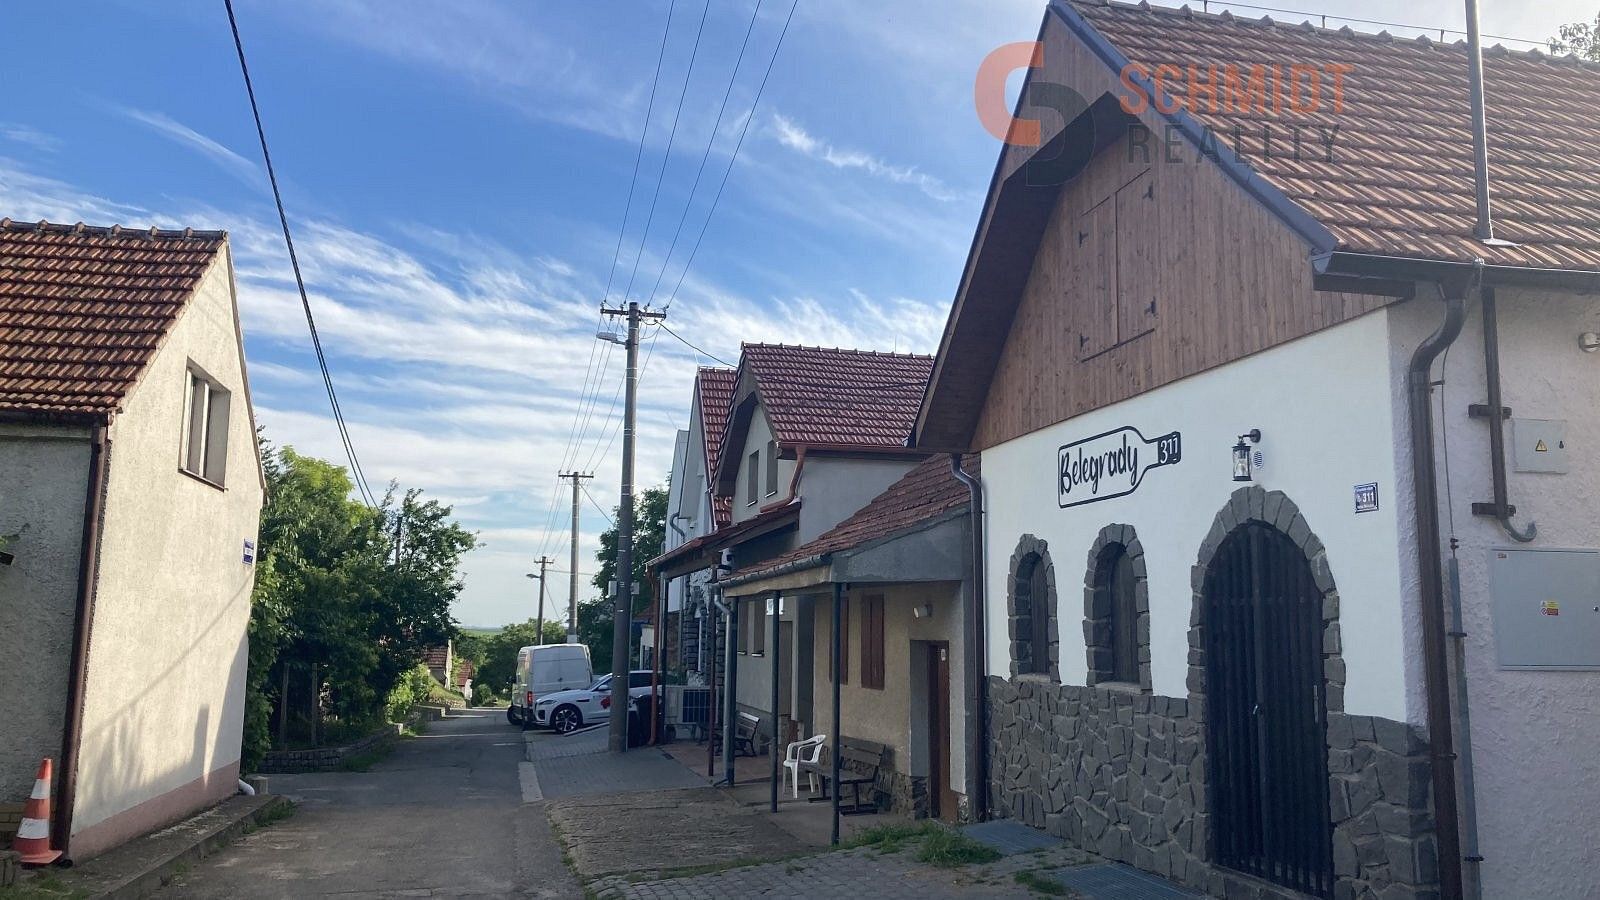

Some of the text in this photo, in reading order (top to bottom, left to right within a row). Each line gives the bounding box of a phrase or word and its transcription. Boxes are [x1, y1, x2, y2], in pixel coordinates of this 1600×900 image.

[1061, 433, 1178, 495] Belegrady 311
[1362, 491, 1374, 502] 311
